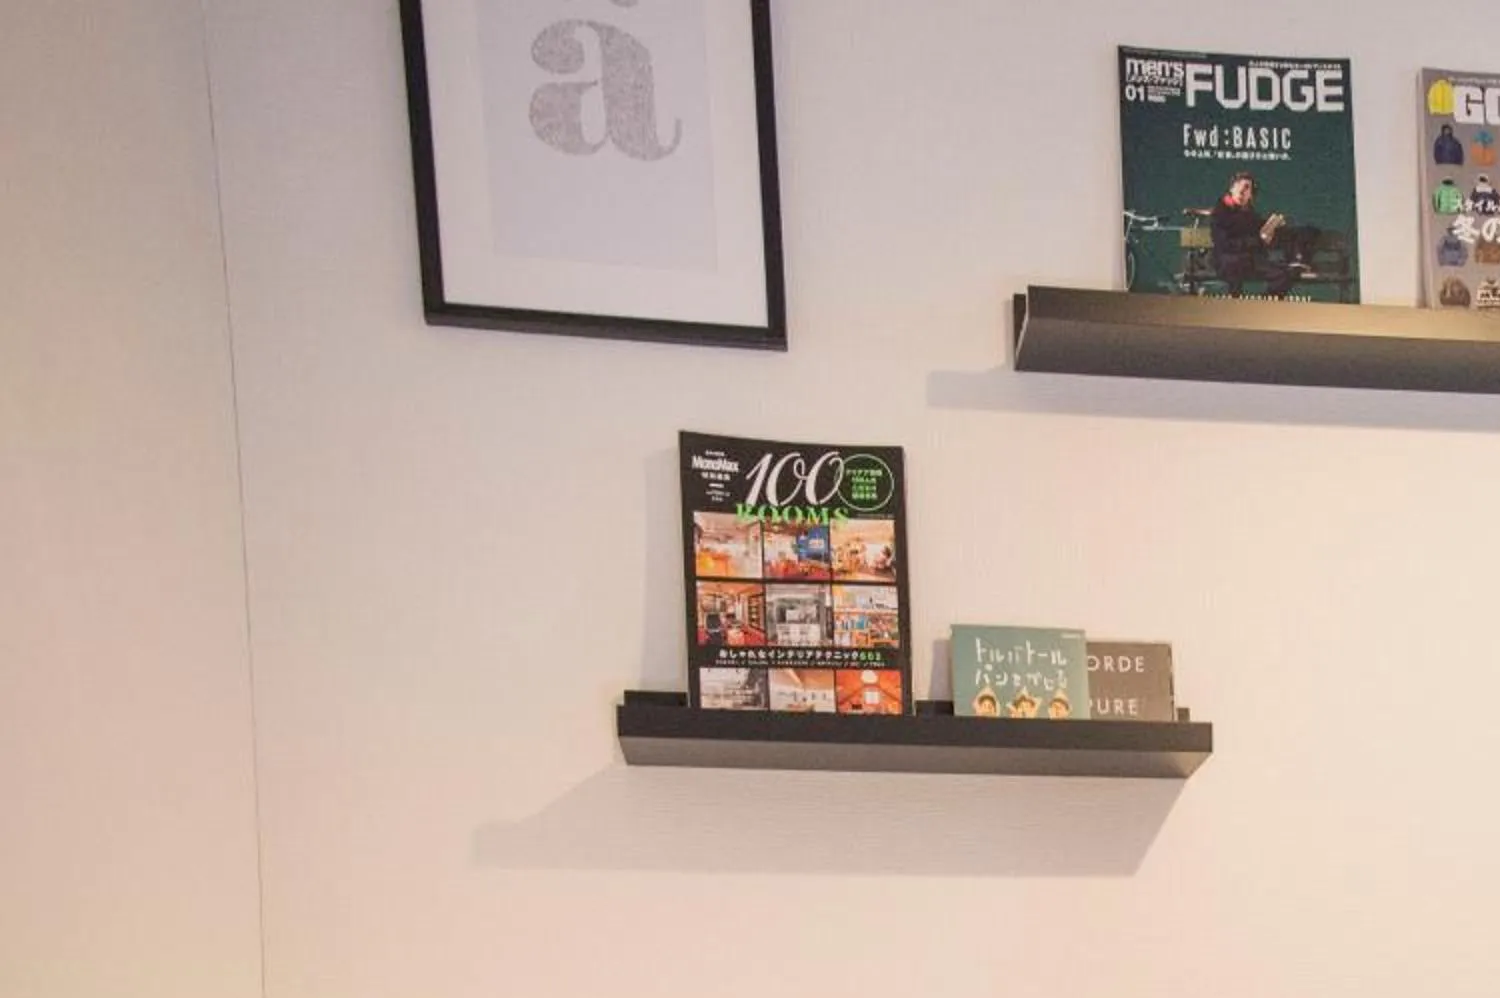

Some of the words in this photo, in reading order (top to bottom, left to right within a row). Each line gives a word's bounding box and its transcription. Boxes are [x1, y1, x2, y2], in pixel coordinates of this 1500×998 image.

[1125, 57, 1184, 78] men's
[1185, 62, 1345, 112] FUDGE
[1125, 84, 1145, 102] 01
[745, 451, 844, 506] 100
[736, 503, 849, 525] ROOMS
[1089, 696, 1138, 716] URE
